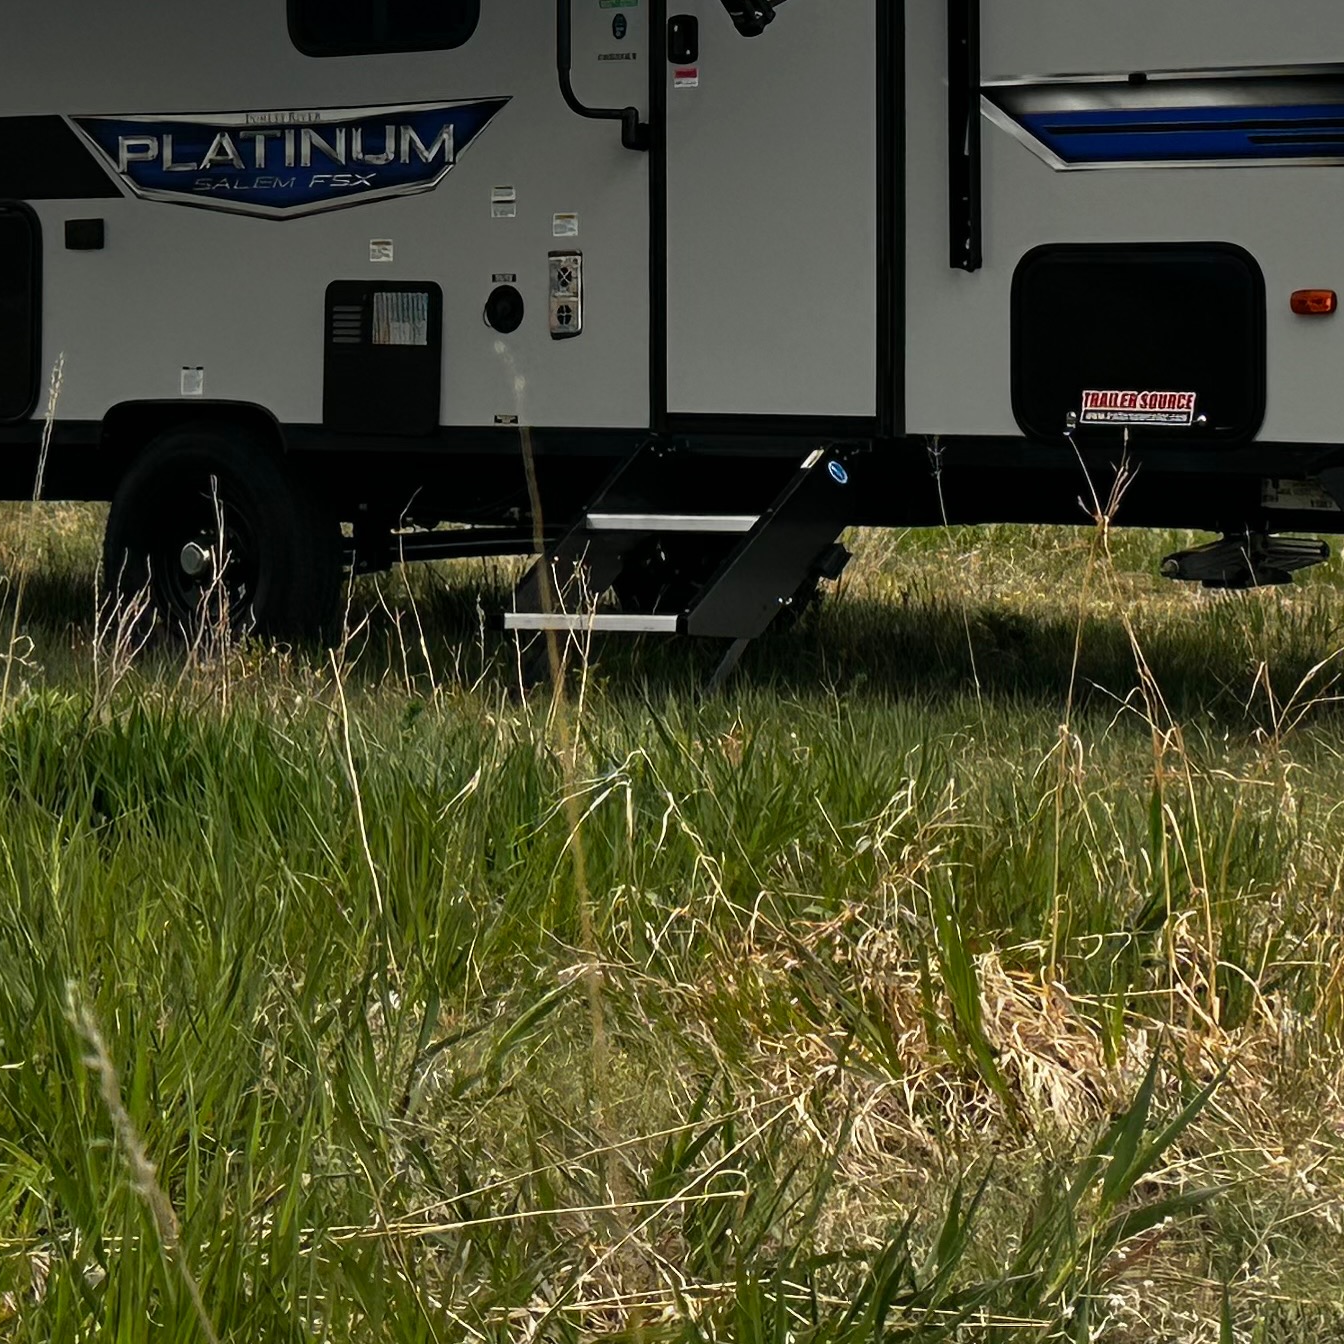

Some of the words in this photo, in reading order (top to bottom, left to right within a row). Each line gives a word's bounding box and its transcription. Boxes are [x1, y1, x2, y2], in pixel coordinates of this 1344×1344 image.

[117, 123, 455, 174] PLATINUM
[192, 176, 296, 191] SALEM
[308, 172, 377, 188] FSX
[1084, 391, 1138, 409] TRAILER
[1139, 392, 1194, 410] SOURCE
